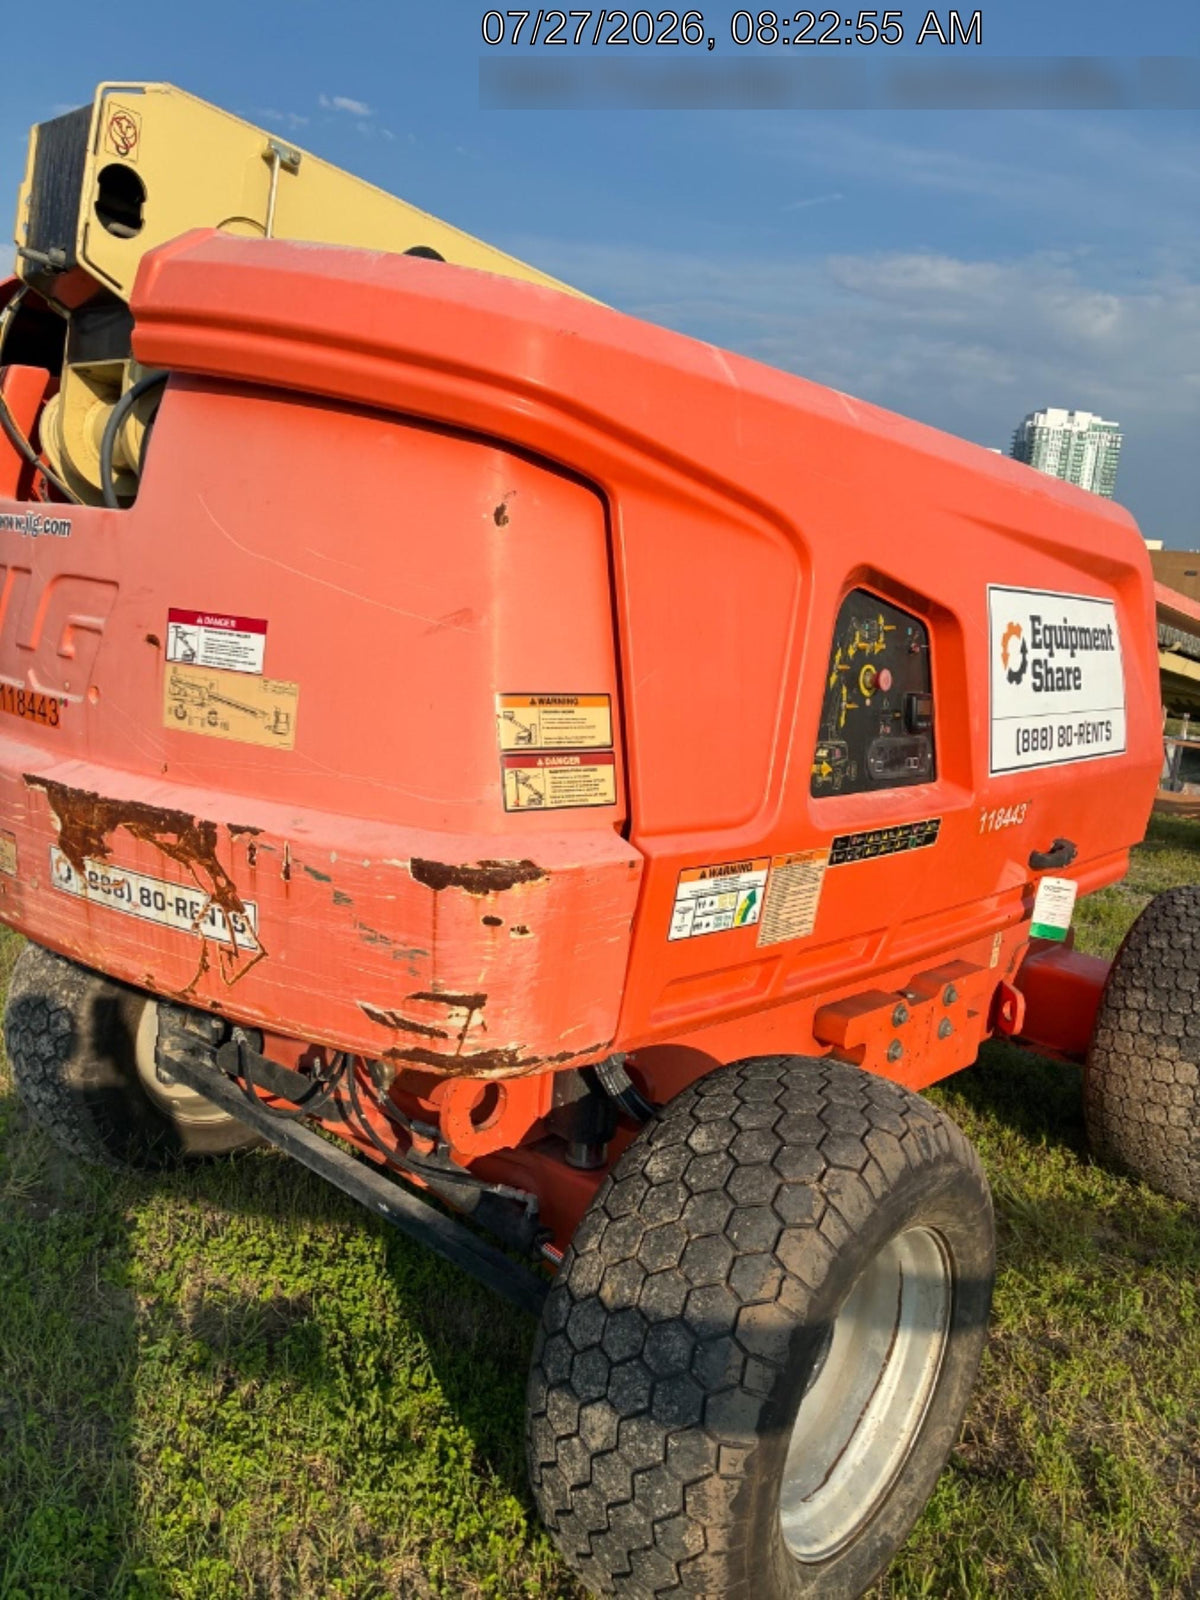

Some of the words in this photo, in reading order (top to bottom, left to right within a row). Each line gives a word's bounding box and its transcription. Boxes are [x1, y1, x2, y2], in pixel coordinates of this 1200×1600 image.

[1029, 614, 1115, 658] Equipment
[1031, 658, 1082, 693] Share
[1016, 724, 1053, 756] (888)
[1057, 719, 1112, 748] 80-RENTS
[979, 802, 1028, 835] 118443
[709, 862, 753, 879] WARNING
